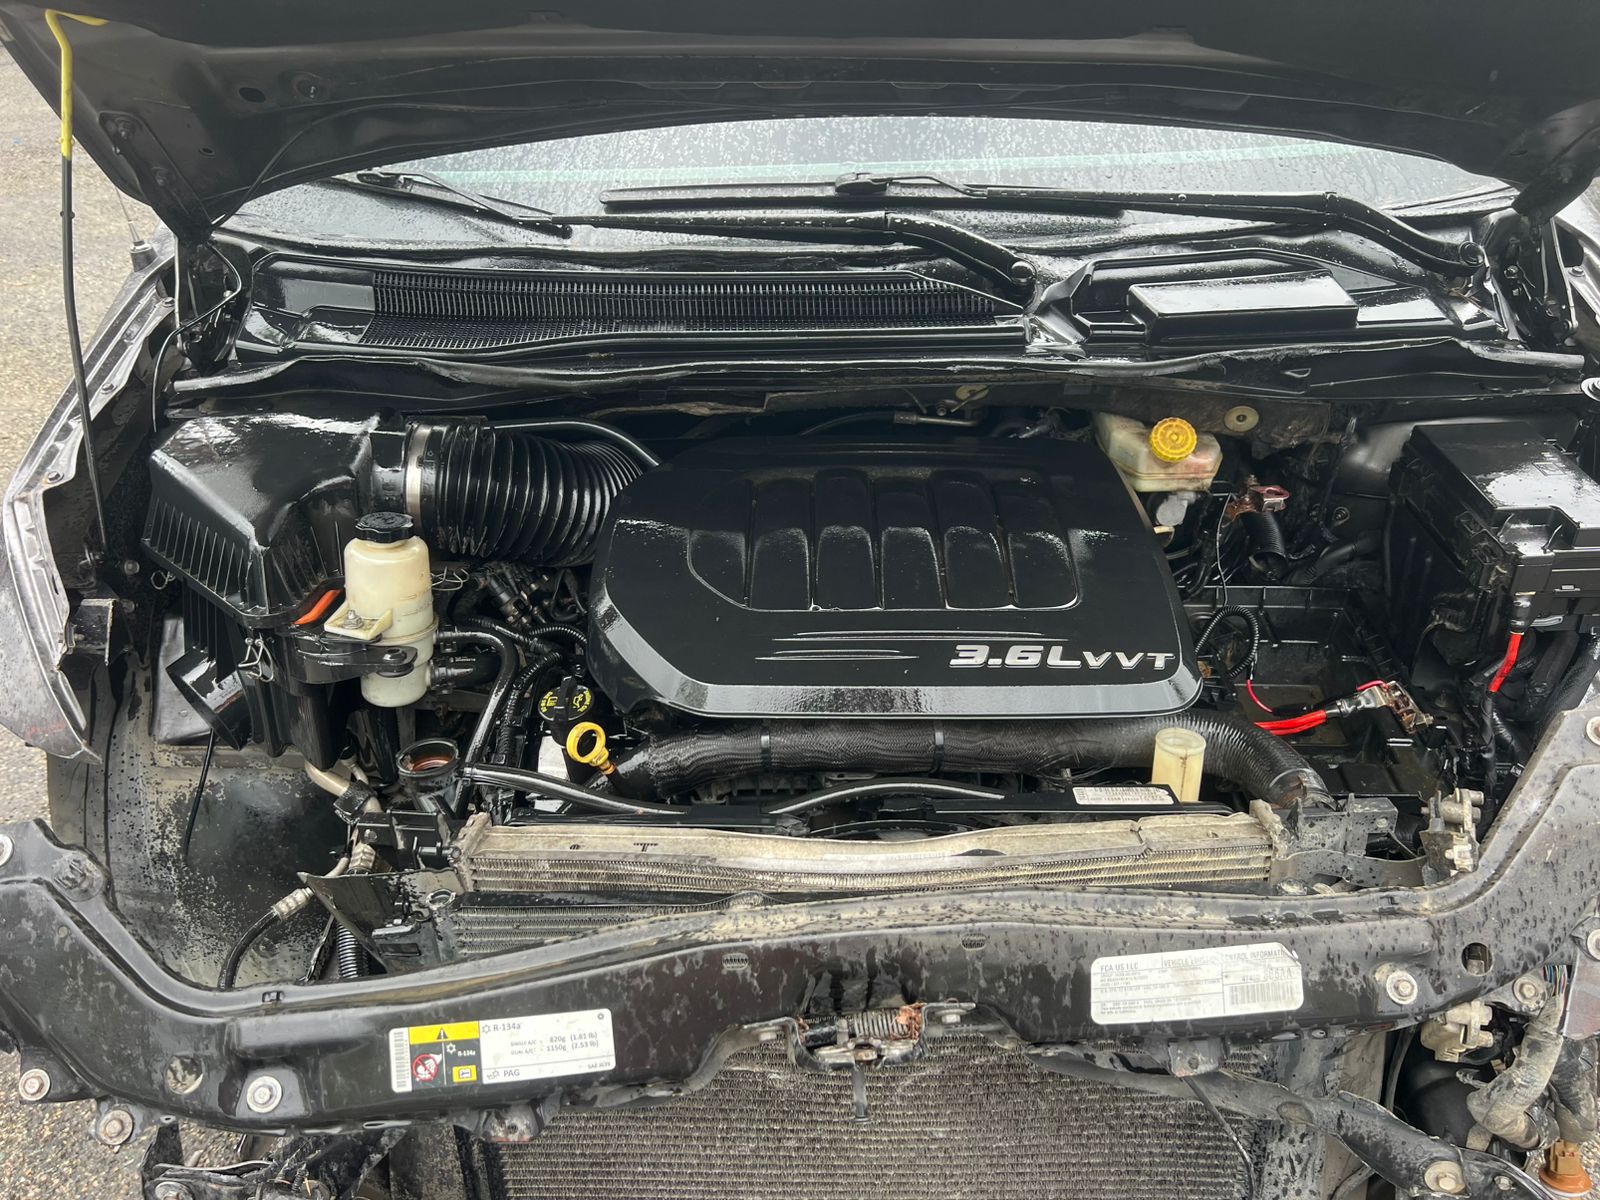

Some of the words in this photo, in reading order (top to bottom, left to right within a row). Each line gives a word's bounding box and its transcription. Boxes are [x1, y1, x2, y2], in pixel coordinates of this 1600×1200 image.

[950, 645, 1081, 668] 3.6L
[1083, 651, 1175, 670] VVT
[1100, 964, 1114, 972] FCA
[493, 1022, 521, 1032] R-134a
[549, 1035, 566, 1044] 820g
[546, 1044, 567, 1053] 1150g
[503, 1069, 520, 1078] PAG
